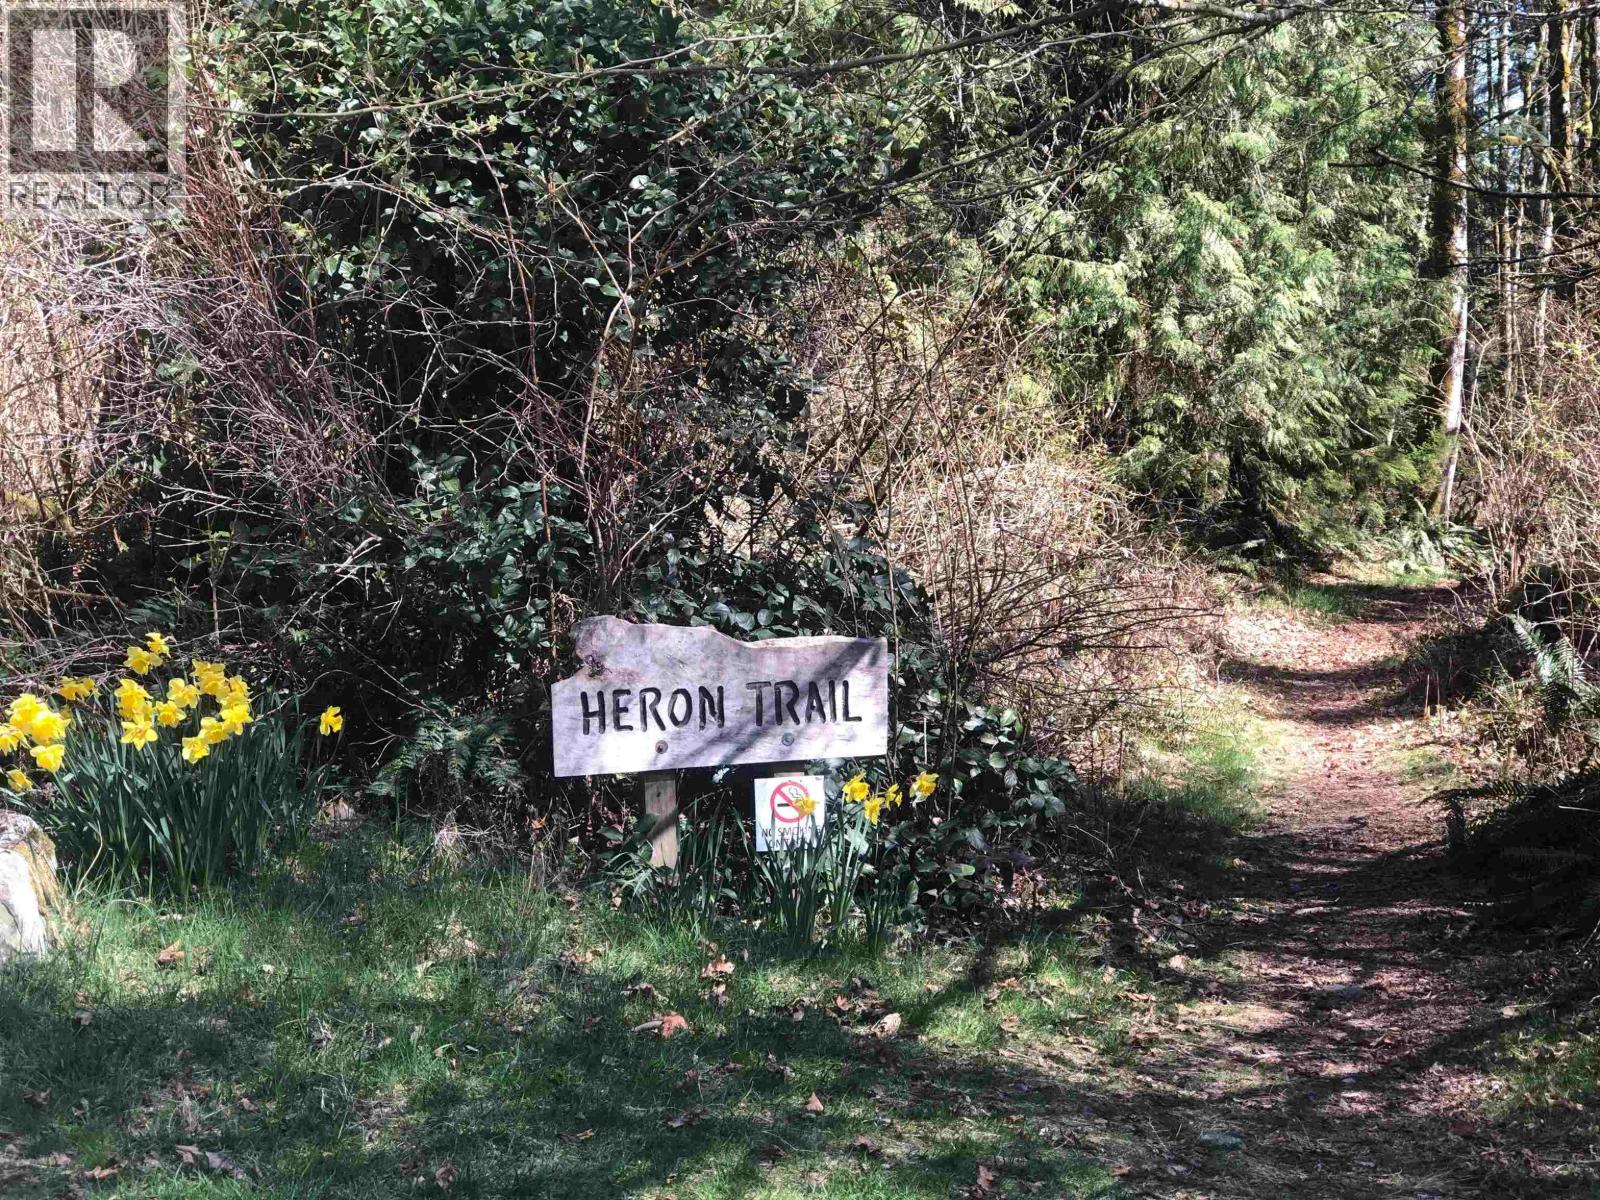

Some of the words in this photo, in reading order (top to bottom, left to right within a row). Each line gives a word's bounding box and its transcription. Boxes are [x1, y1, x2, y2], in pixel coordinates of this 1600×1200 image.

[580, 686, 725, 735] HERON
[746, 679, 863, 727] TRAIL
[778, 825, 821, 836] SMOK
